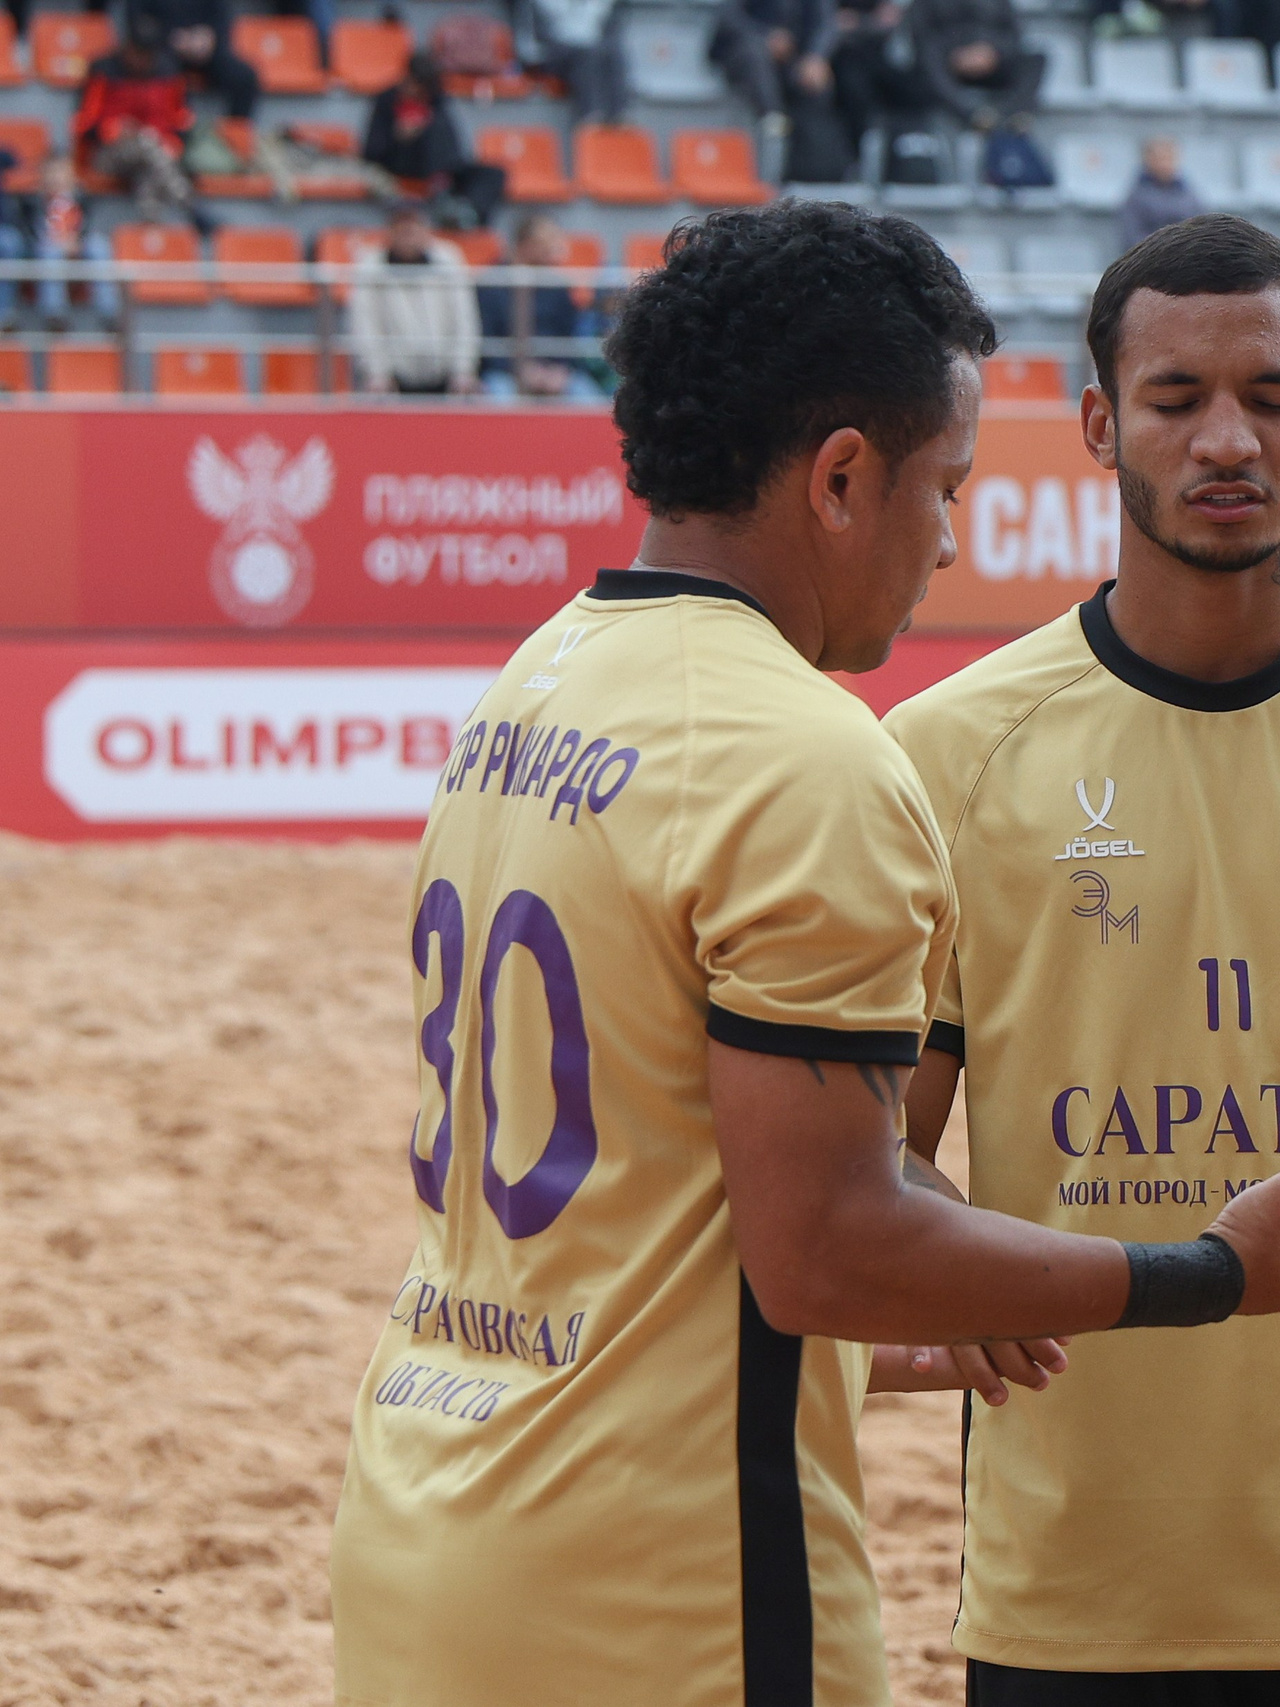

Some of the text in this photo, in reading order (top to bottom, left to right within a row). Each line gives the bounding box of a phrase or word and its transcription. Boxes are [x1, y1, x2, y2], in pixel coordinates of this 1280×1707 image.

[364, 468, 623, 526] ПЛЯЖНЫЙ
[364, 533, 568, 586] ФУТБОЛ
[94, 713, 452, 773] OLIMPB
[479, 721, 640, 826] РИКАРДО
[1055, 837, 1146, 861] JÖGEL
[1198, 958, 1251, 1031] 11
[410, 878, 598, 1239] 30
[1058, 1177, 1110, 1206] МОЙ
